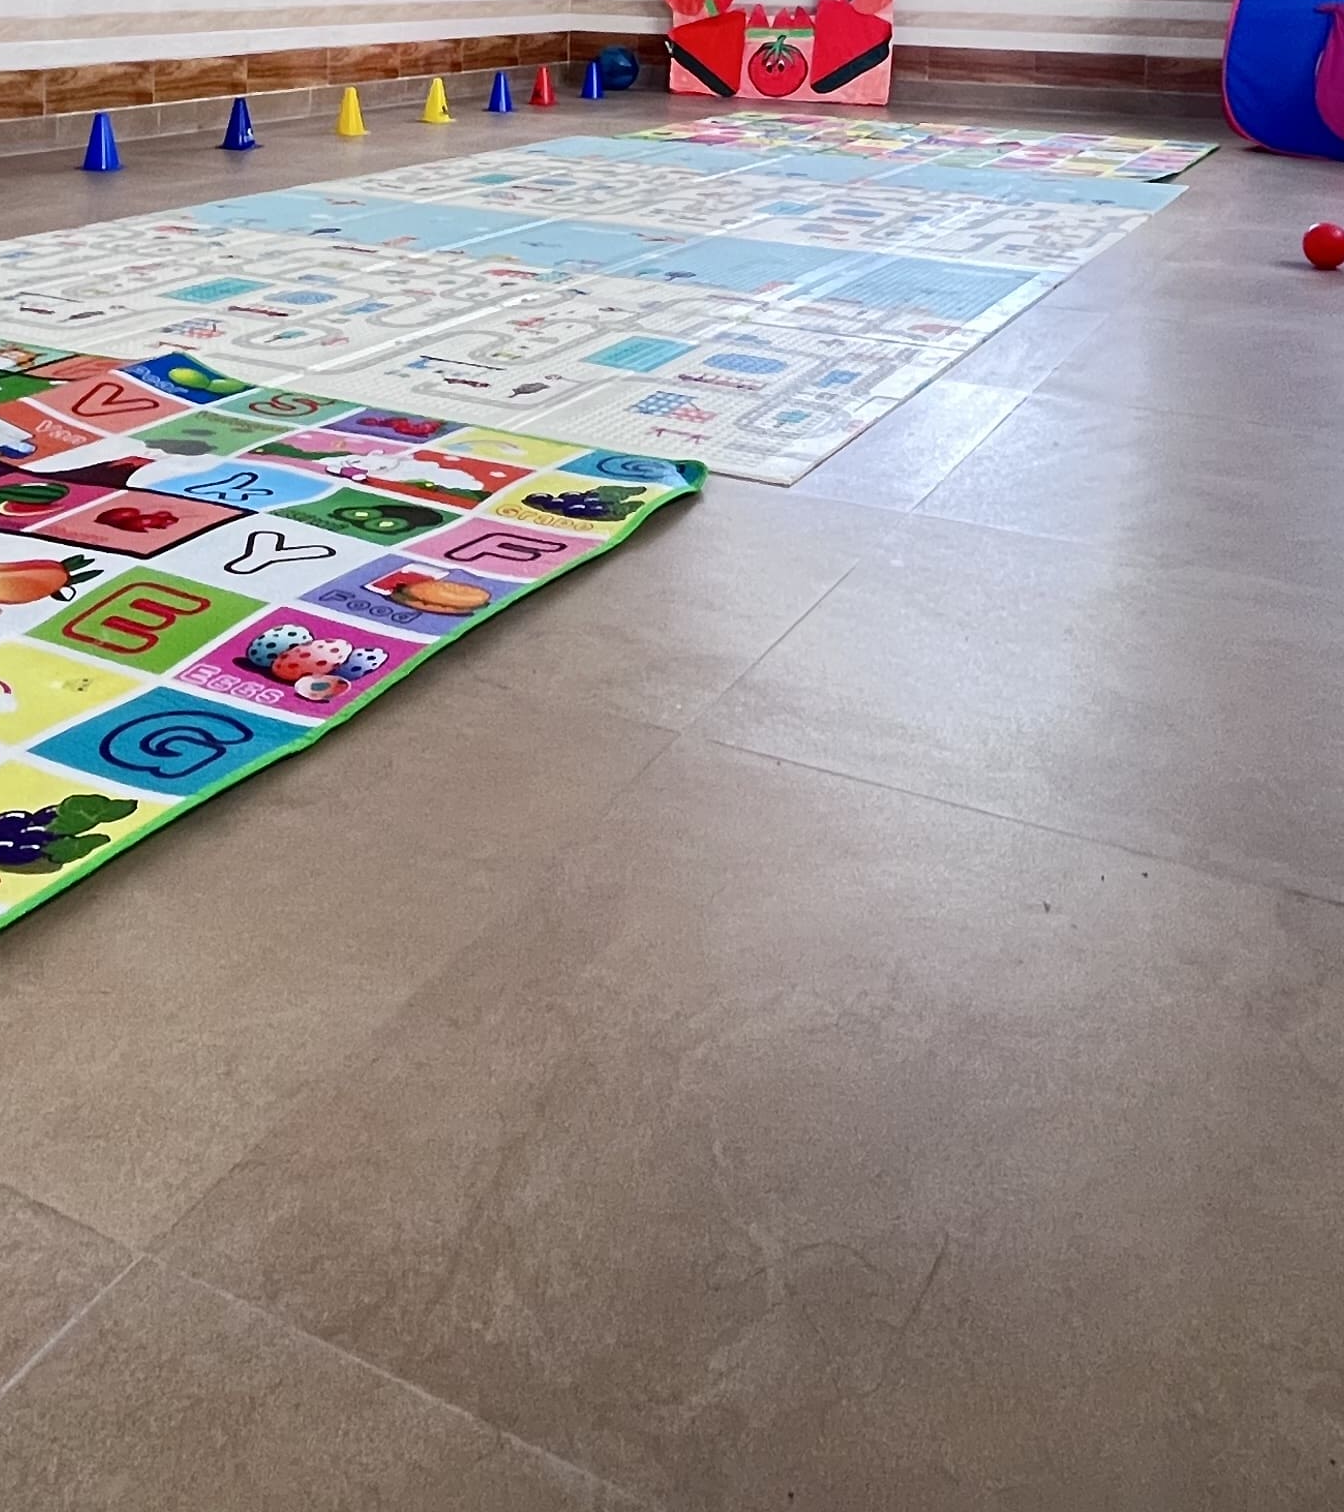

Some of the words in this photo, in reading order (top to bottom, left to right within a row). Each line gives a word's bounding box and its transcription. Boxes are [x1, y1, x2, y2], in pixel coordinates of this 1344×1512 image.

[72, 382, 159, 417] V
[223, 530, 337, 575] Y
[444, 532, 568, 563] F
[61, 582, 211, 655] E
[317, 589, 425, 625] Food
[180, 664, 286, 706] Eggs
[99, 709, 255, 779] G
